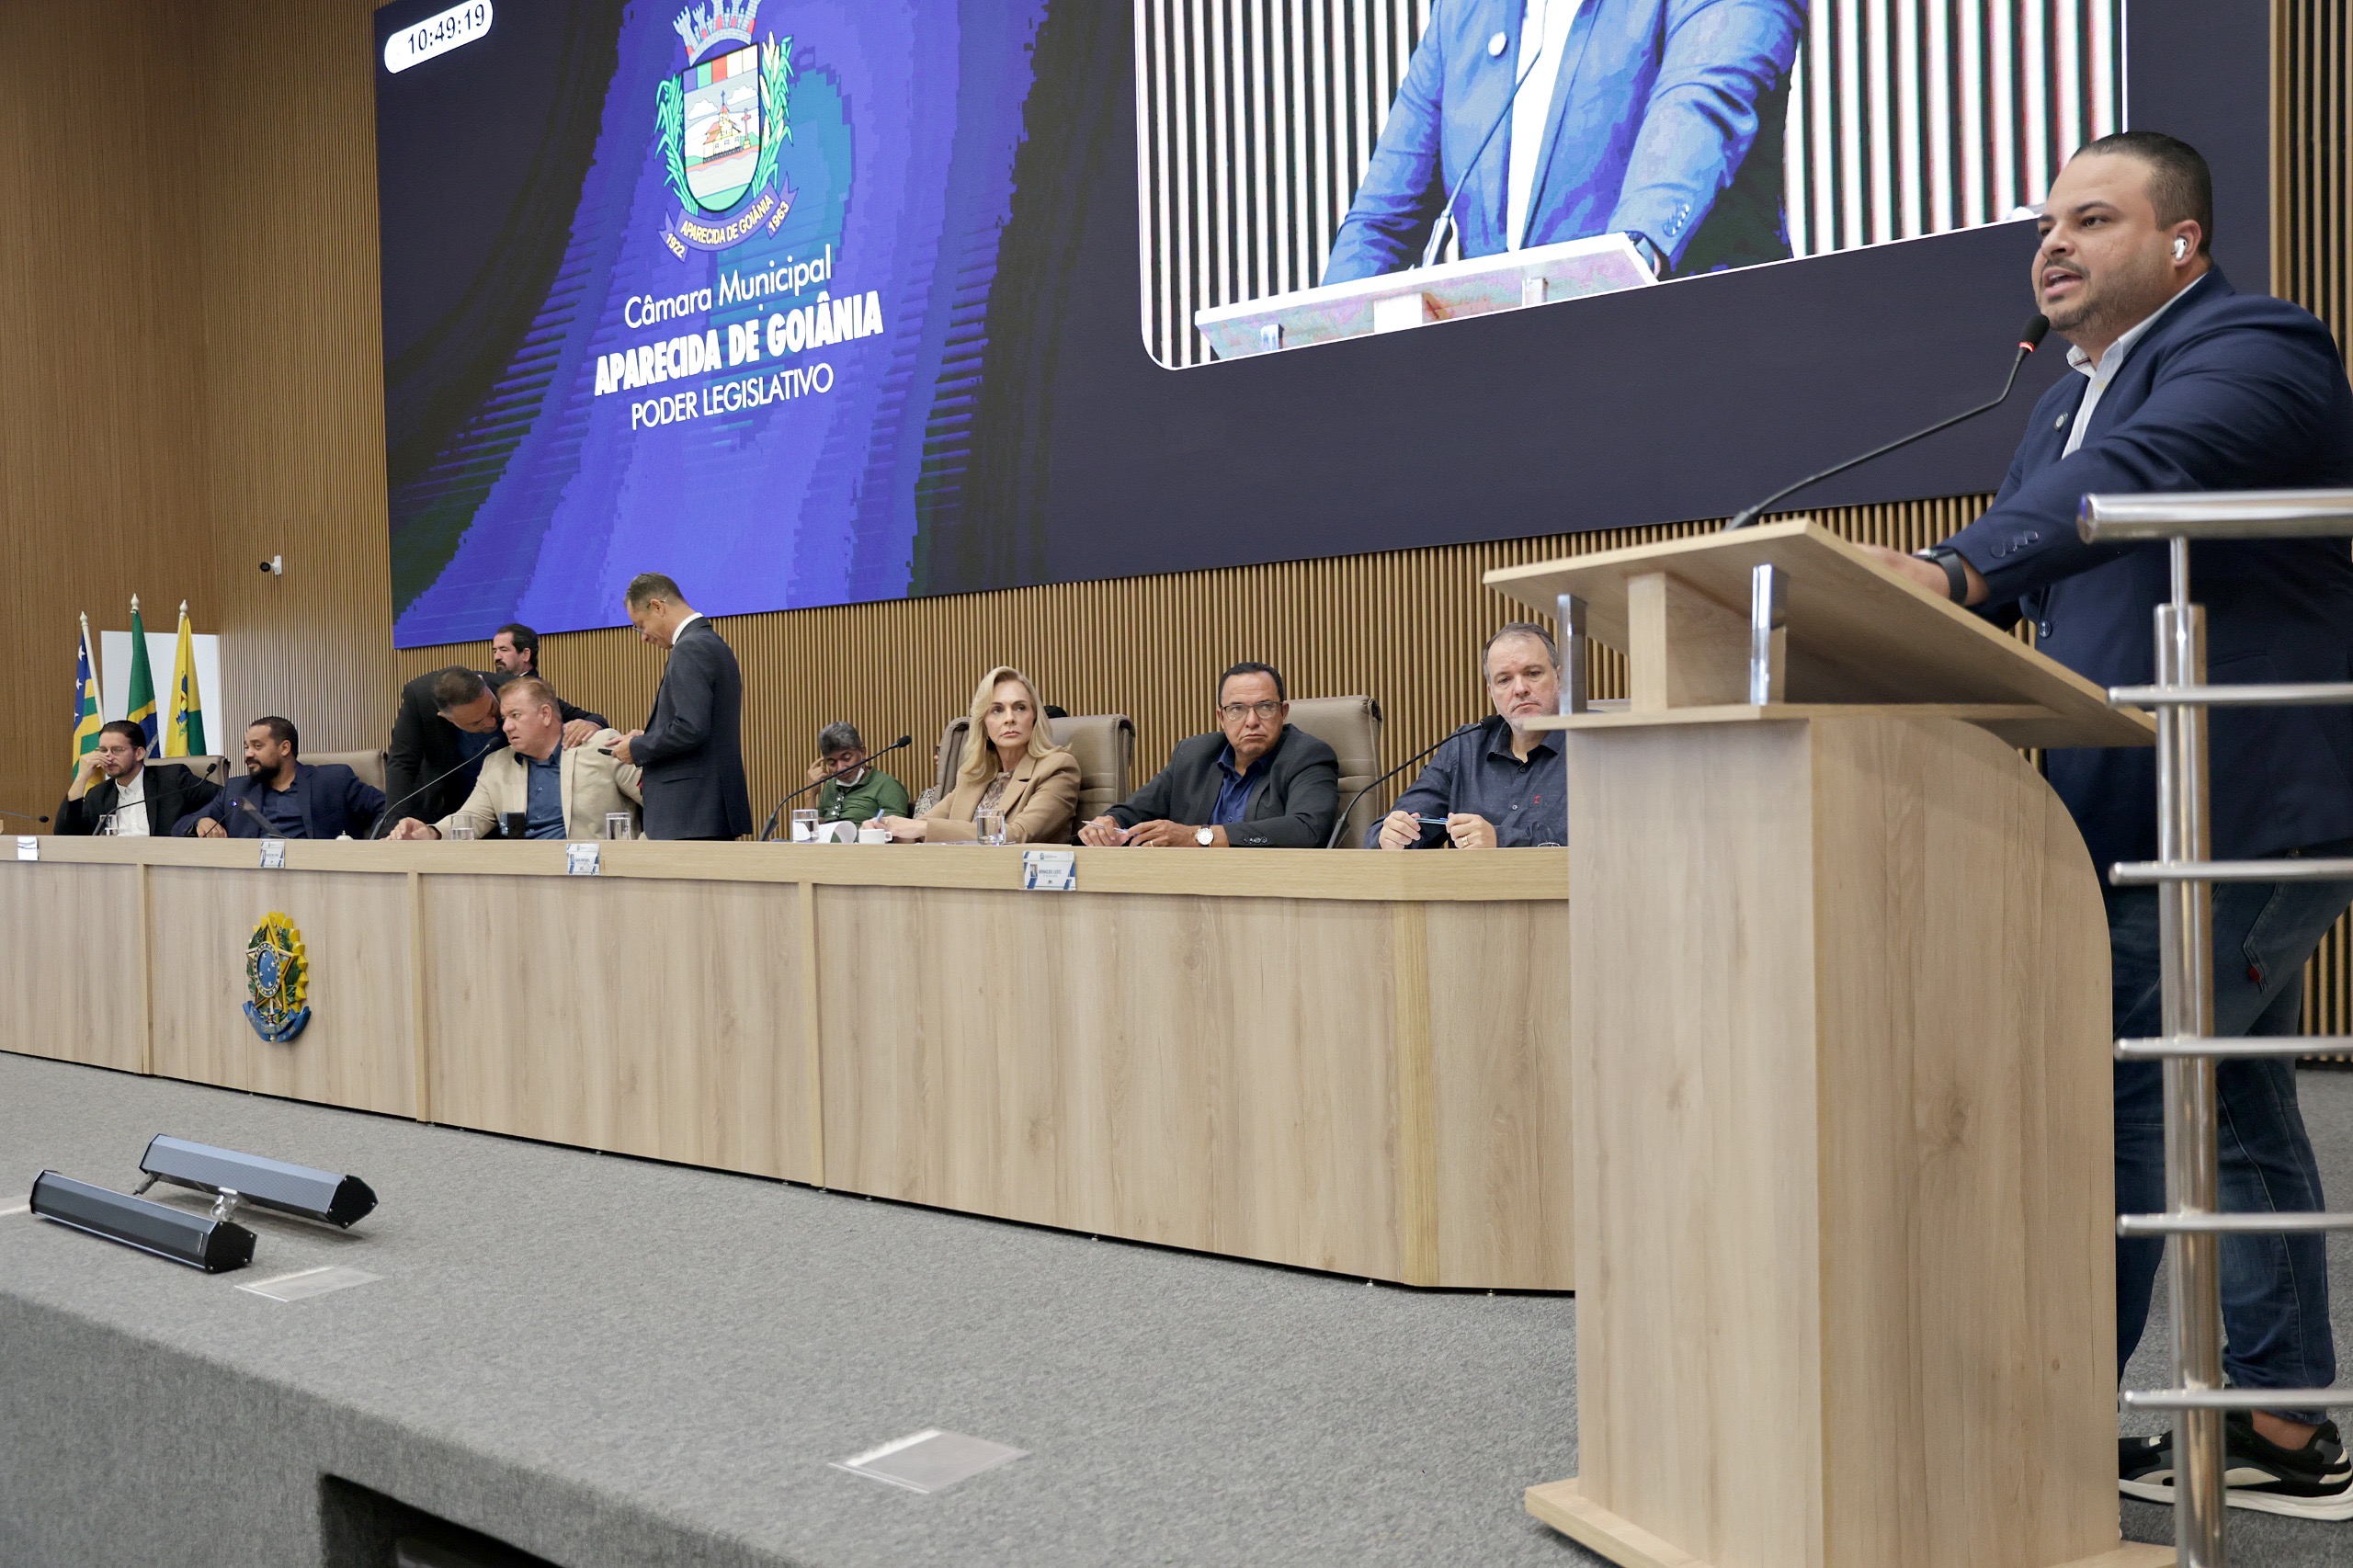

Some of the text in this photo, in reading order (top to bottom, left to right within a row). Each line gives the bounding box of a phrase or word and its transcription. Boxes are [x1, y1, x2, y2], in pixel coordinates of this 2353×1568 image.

[407, 4, 485, 55] 10:49:19
[679, 193, 775, 245] APARECIDA DE GOIÂNIA
[767, 199, 790, 233] 1963
[665, 233, 687, 259] 1922
[624, 244, 832, 329] Câmara Municipal
[594, 290, 884, 396] APARECIDA DE GOIÂNIA
[631, 362, 835, 430] PODER LEGISLATIVO
